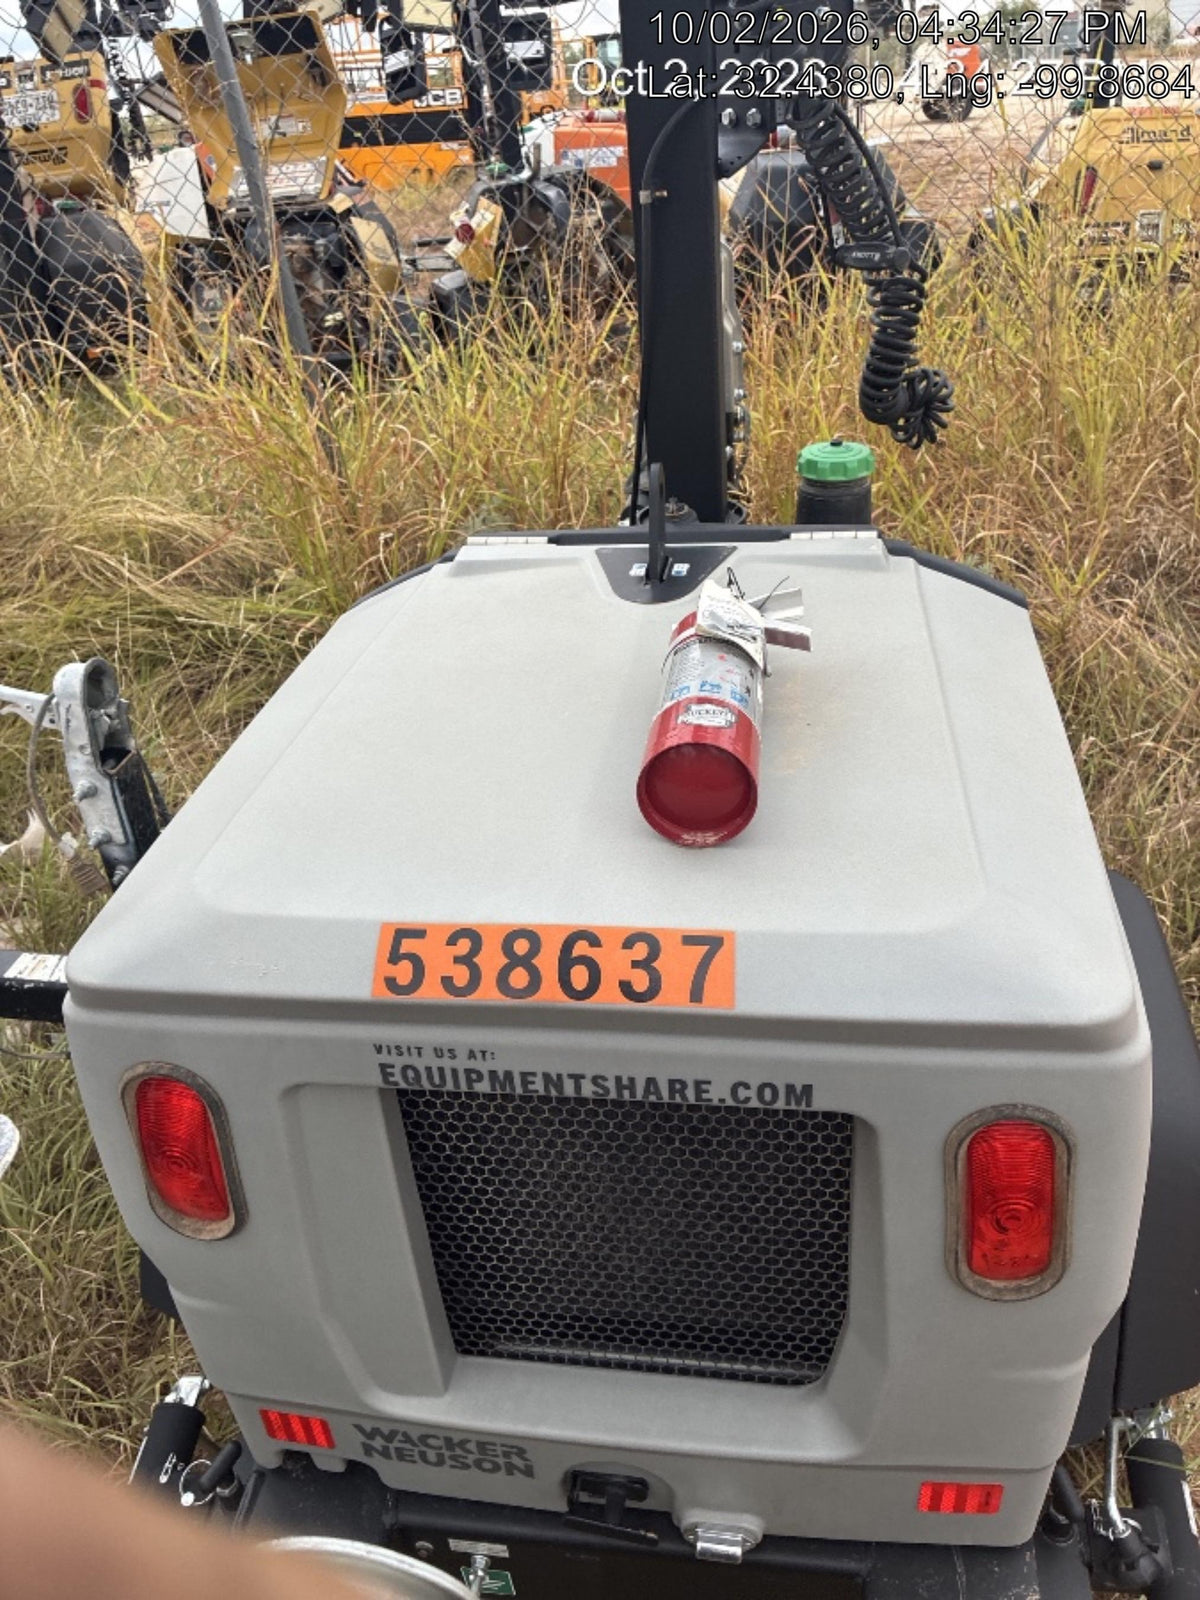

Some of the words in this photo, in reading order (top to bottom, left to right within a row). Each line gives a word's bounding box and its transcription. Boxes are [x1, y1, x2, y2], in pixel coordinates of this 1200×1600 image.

[413, 88, 463, 108] JCB
[383, 927, 724, 1004] 538637
[373, 1043, 424, 1059] VISIT
[434, 1046, 457, 1060] US
[467, 1048, 496, 1061] AT:
[377, 1062, 814, 1108] EQUIPMENTSHARE.COM
[352, 1423, 533, 1462] WACKER
[361, 1441, 536, 1479] NEUSON
